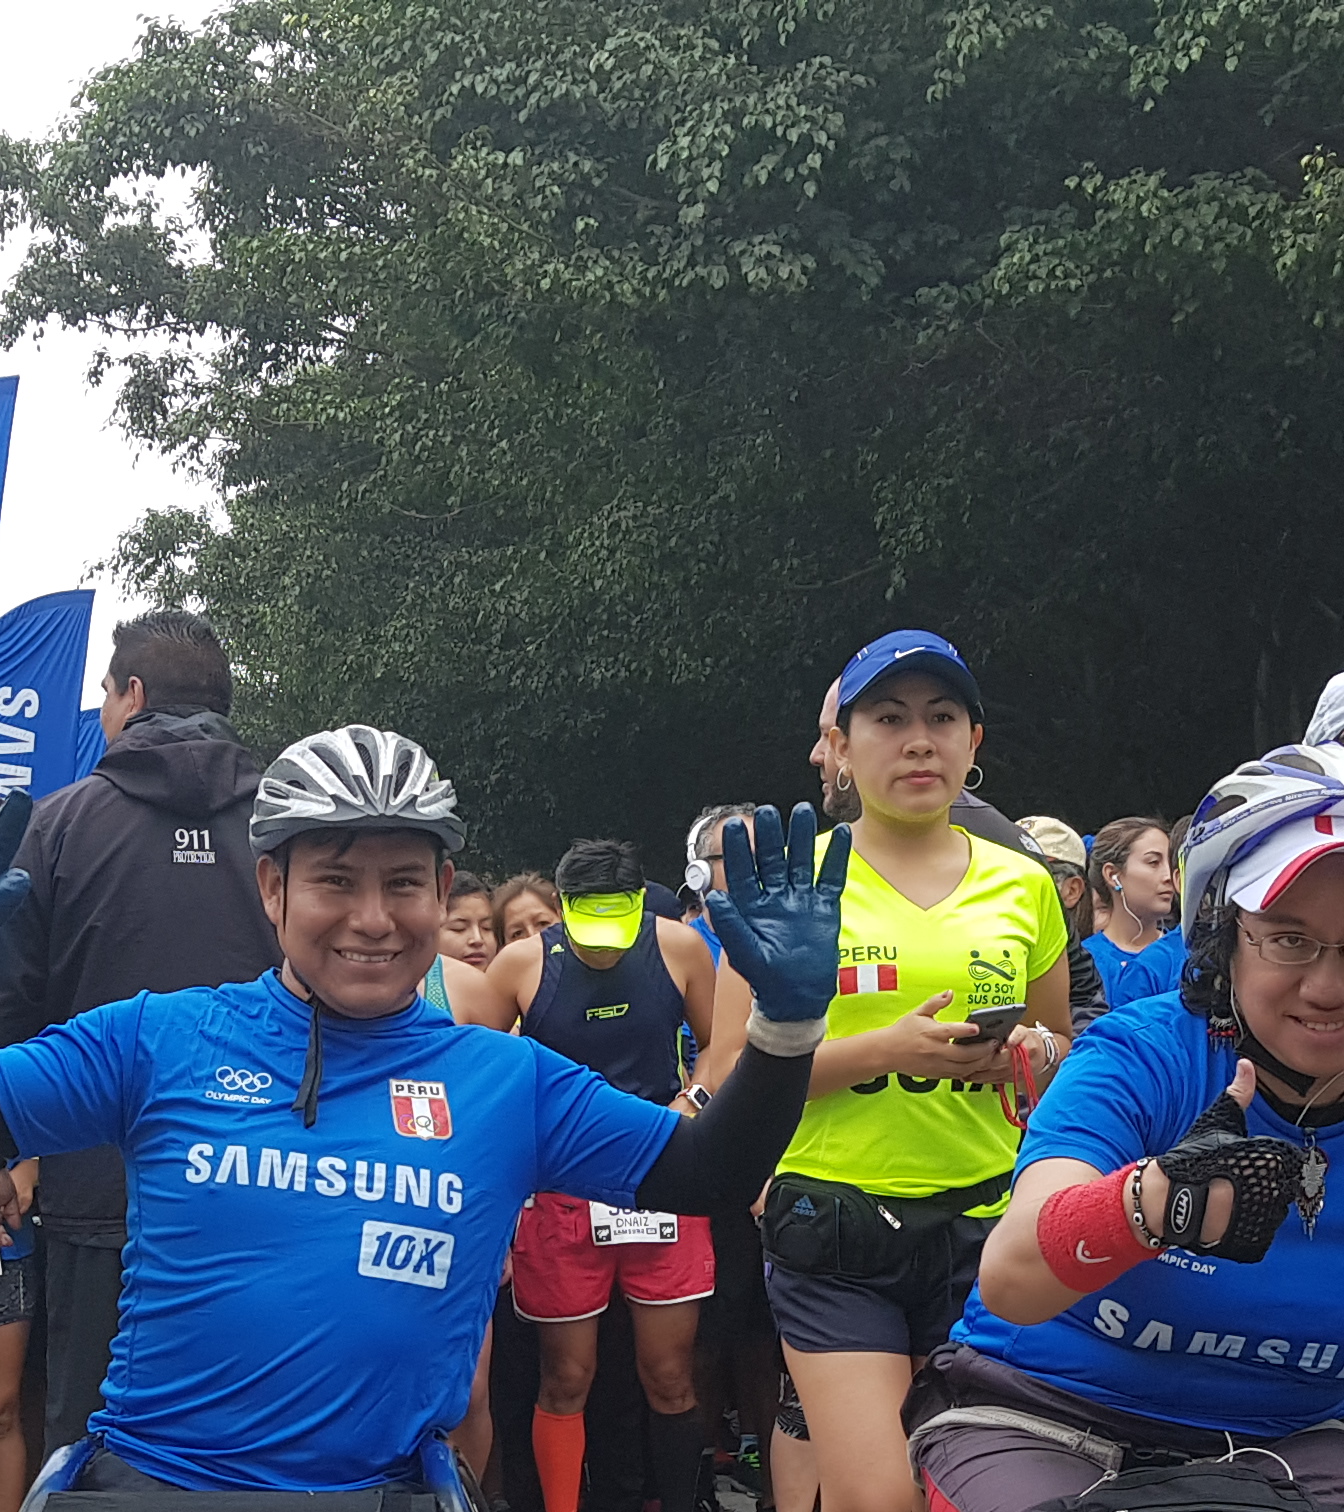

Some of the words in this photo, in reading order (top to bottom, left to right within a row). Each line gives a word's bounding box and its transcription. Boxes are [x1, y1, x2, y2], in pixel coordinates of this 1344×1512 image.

[174, 828, 210, 850] 911
[838, 945, 897, 964] PERU
[973, 983, 992, 993] YO
[994, 983, 1015, 995] SOY
[967, 994, 988, 1005] SUS
[991, 995, 1016, 1006] OJOS
[394, 1083, 441, 1096] PERU
[205, 1090, 249, 1104] OLYMPIC
[250, 1096, 272, 1105] DAY
[185, 1142, 463, 1214] SAMSUNG
[370, 1230, 446, 1278] 10K
[1190, 1261, 1217, 1276] DAY
